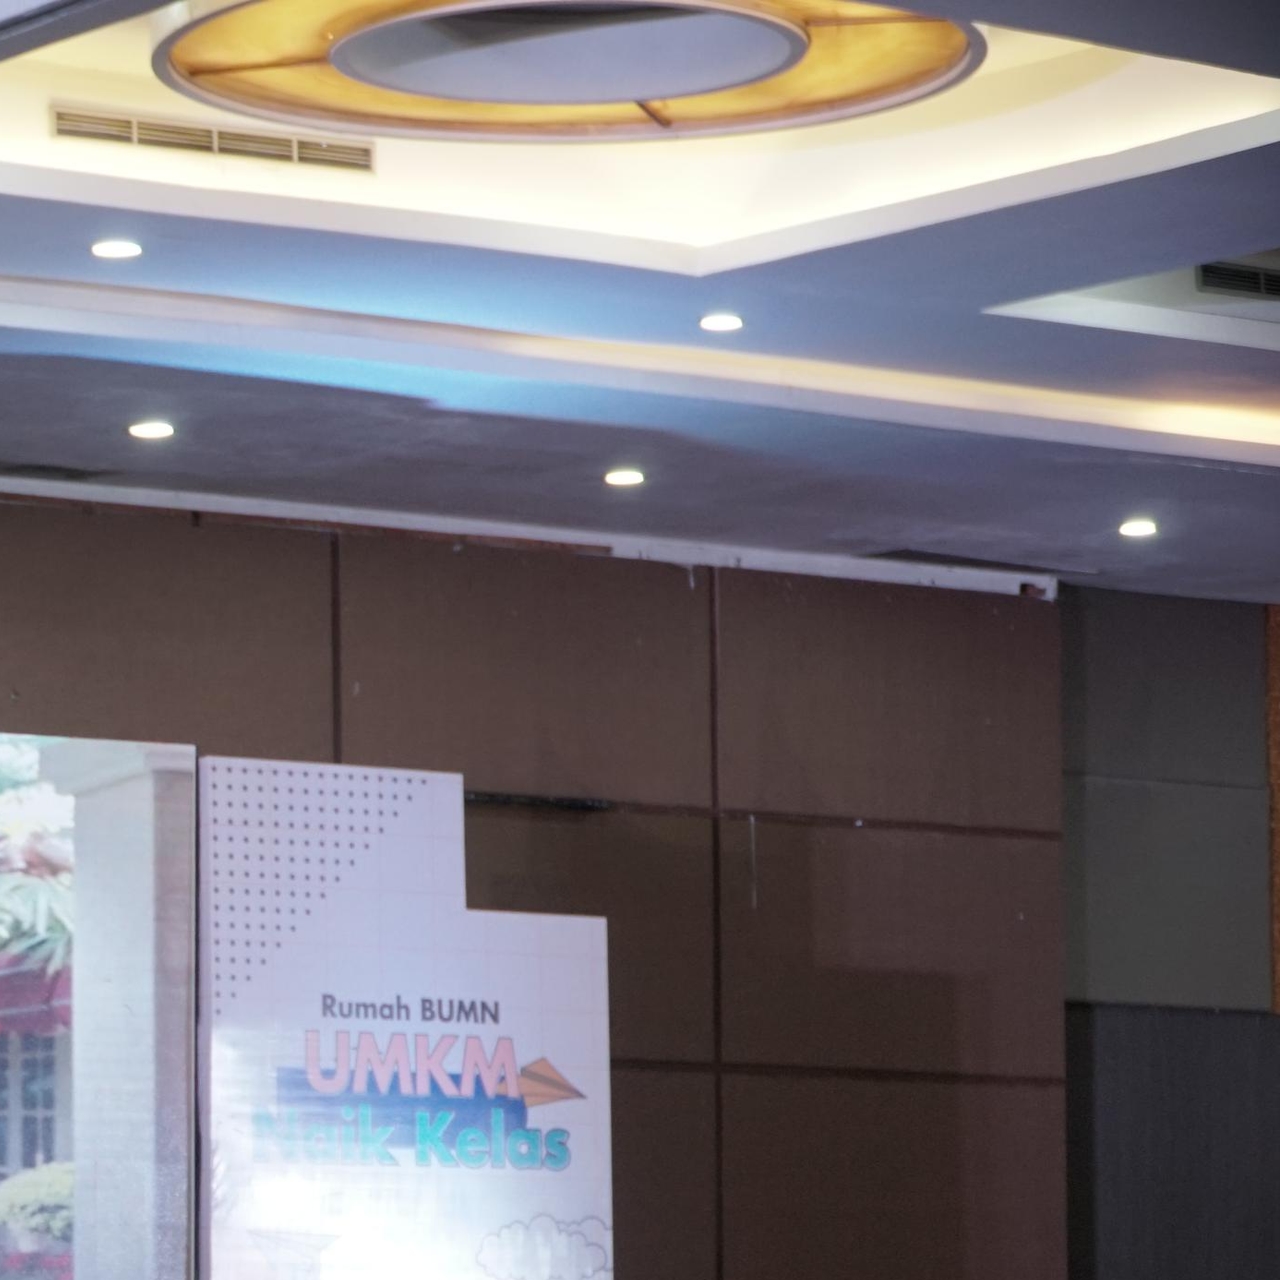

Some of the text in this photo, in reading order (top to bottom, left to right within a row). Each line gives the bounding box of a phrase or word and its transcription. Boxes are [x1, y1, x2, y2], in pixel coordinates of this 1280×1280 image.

[322, 994, 500, 1024] Rumah BUMN
[305, 1030, 520, 1099] UMKM
[251, 1103, 572, 1169] Naik Kelas
